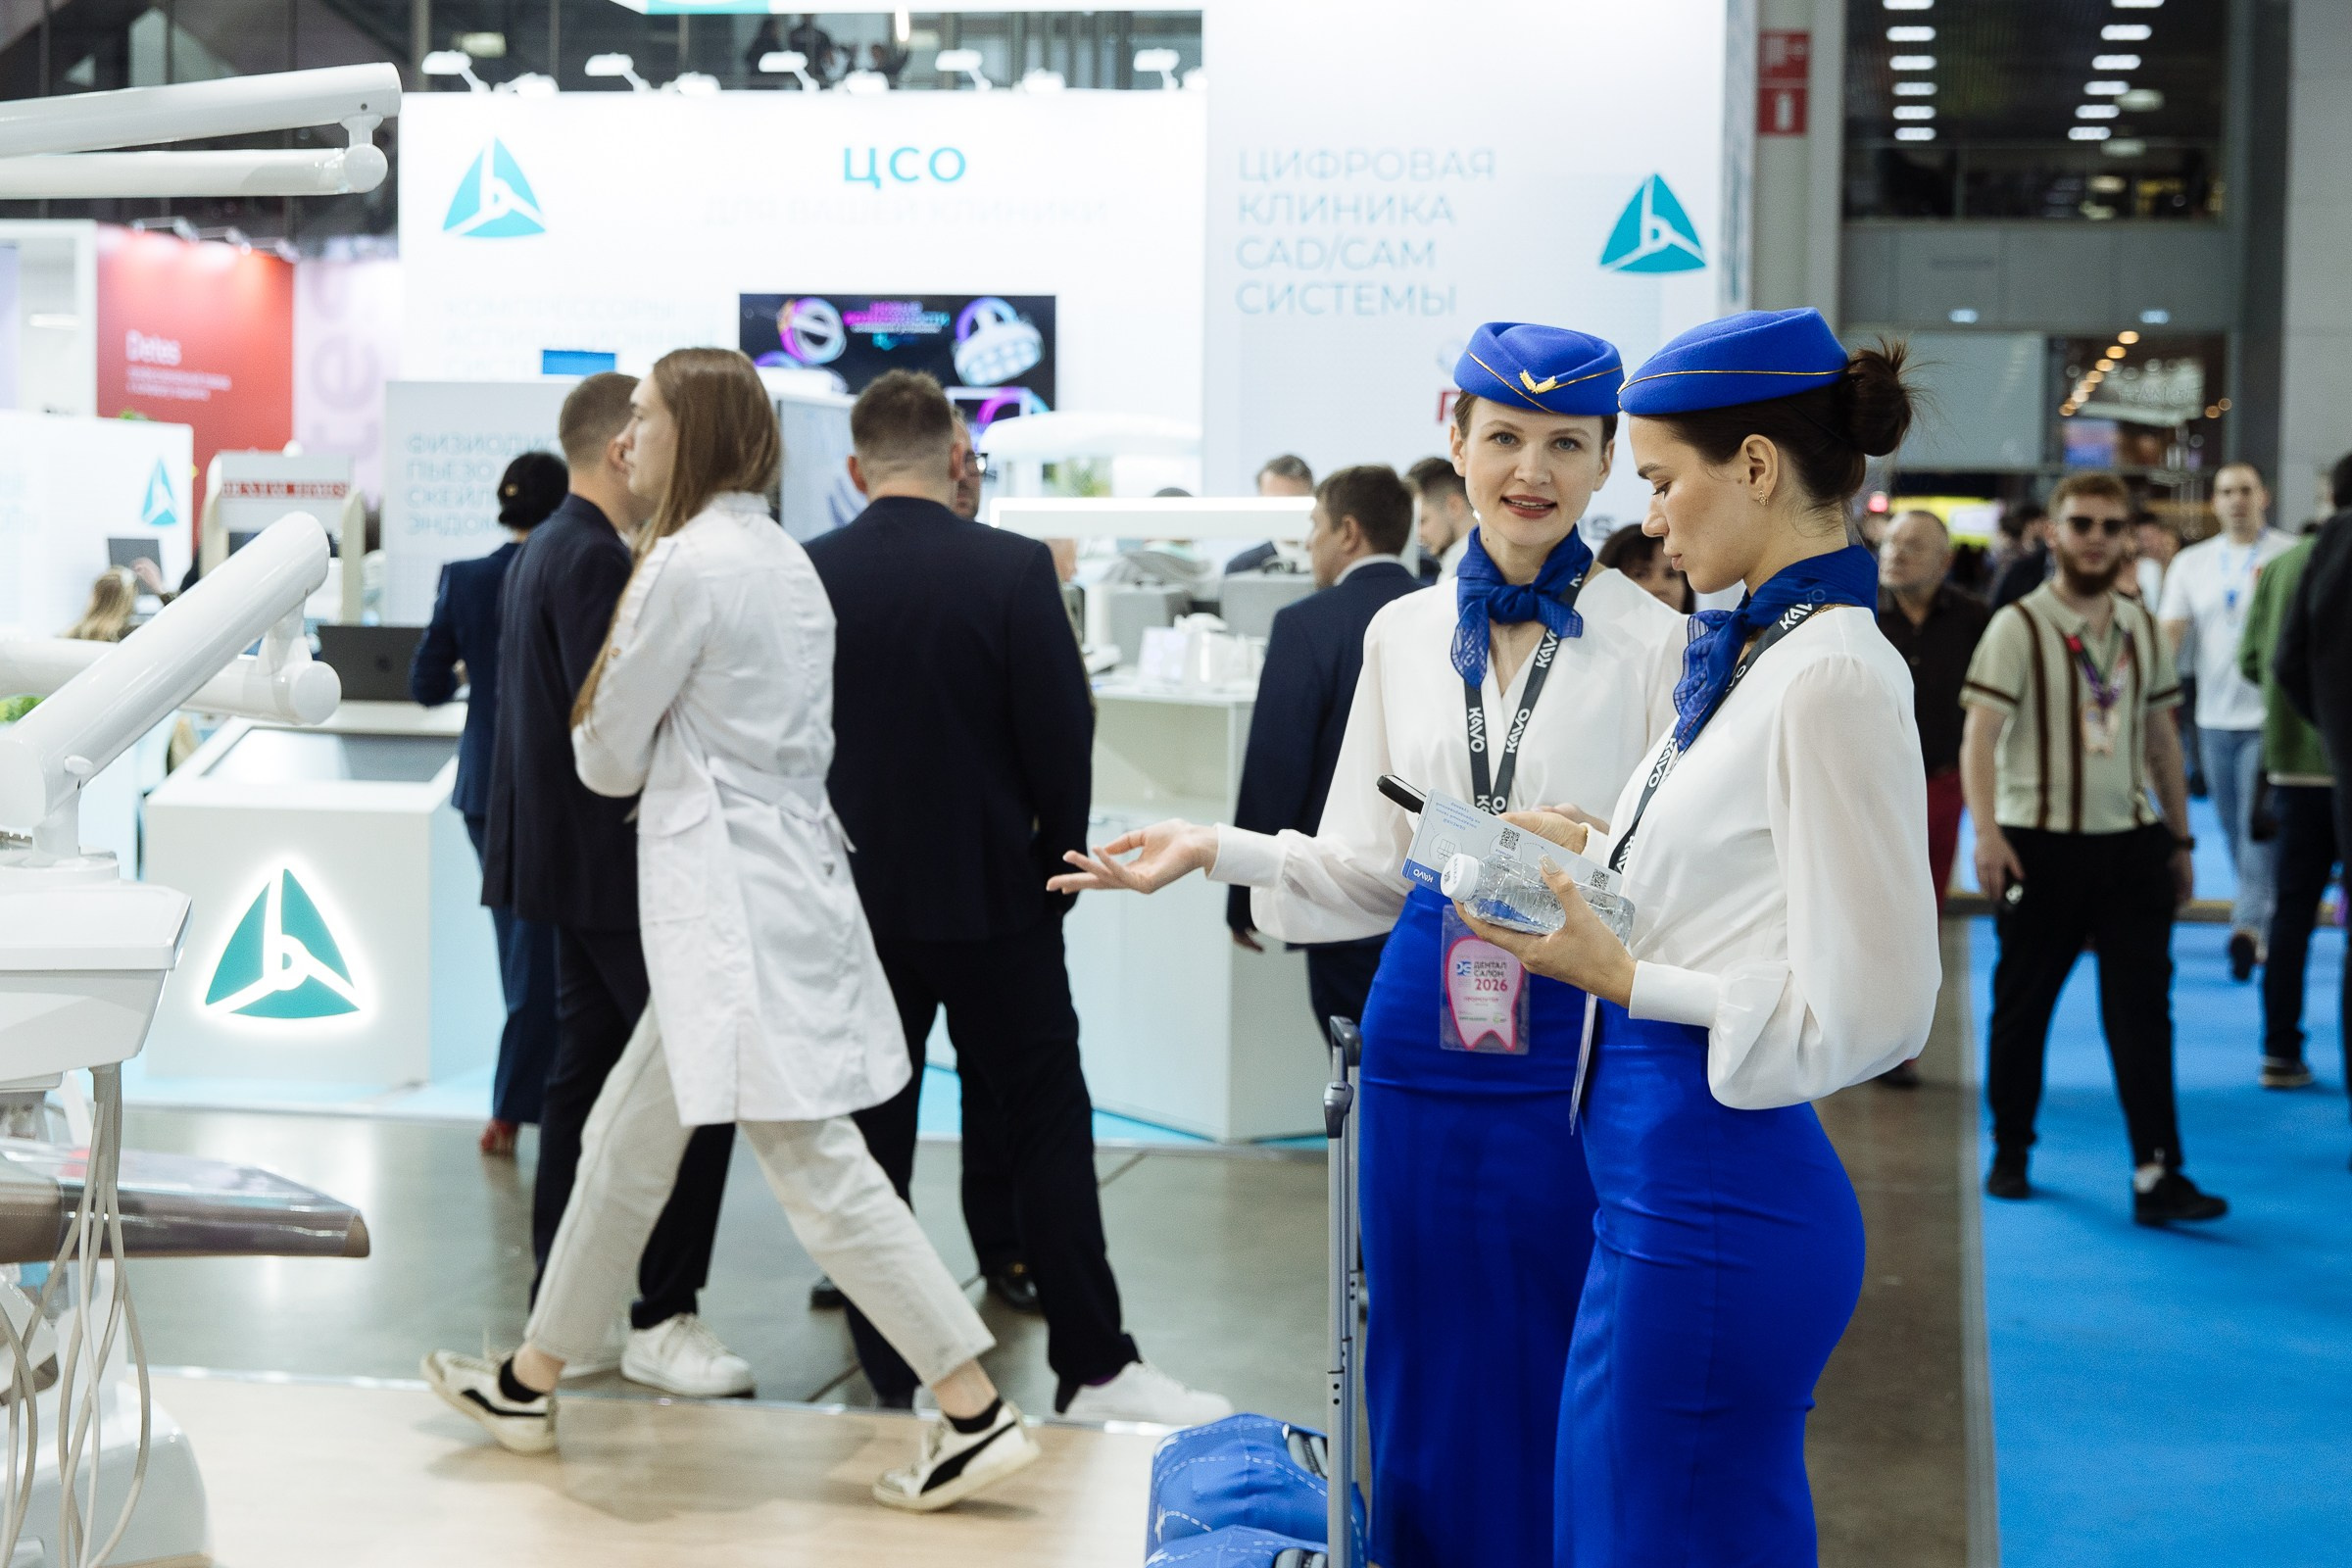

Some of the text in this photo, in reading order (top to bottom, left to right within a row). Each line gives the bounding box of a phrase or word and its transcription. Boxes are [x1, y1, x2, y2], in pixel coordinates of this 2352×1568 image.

[843, 146, 967, 189] ЦСО
[1238, 147, 1495, 185] ЦИФРОВАЯ
[1237, 193, 1456, 226] КЛИНИКА
[1235, 232, 1437, 272] CAD/CAM
[1235, 280, 1457, 317] СИСТЕМЫ
[405, 484, 496, 510] СКЕЙЛ
[1536, 628, 1560, 668] KAV
[1468, 707, 1486, 753] KAVO
[1505, 708, 1531, 754] KAVO
[1413, 868, 1434, 883] KAVO
[1473, 969, 1504, 978] САЛОН
[1475, 978, 1508, 992] 2026
